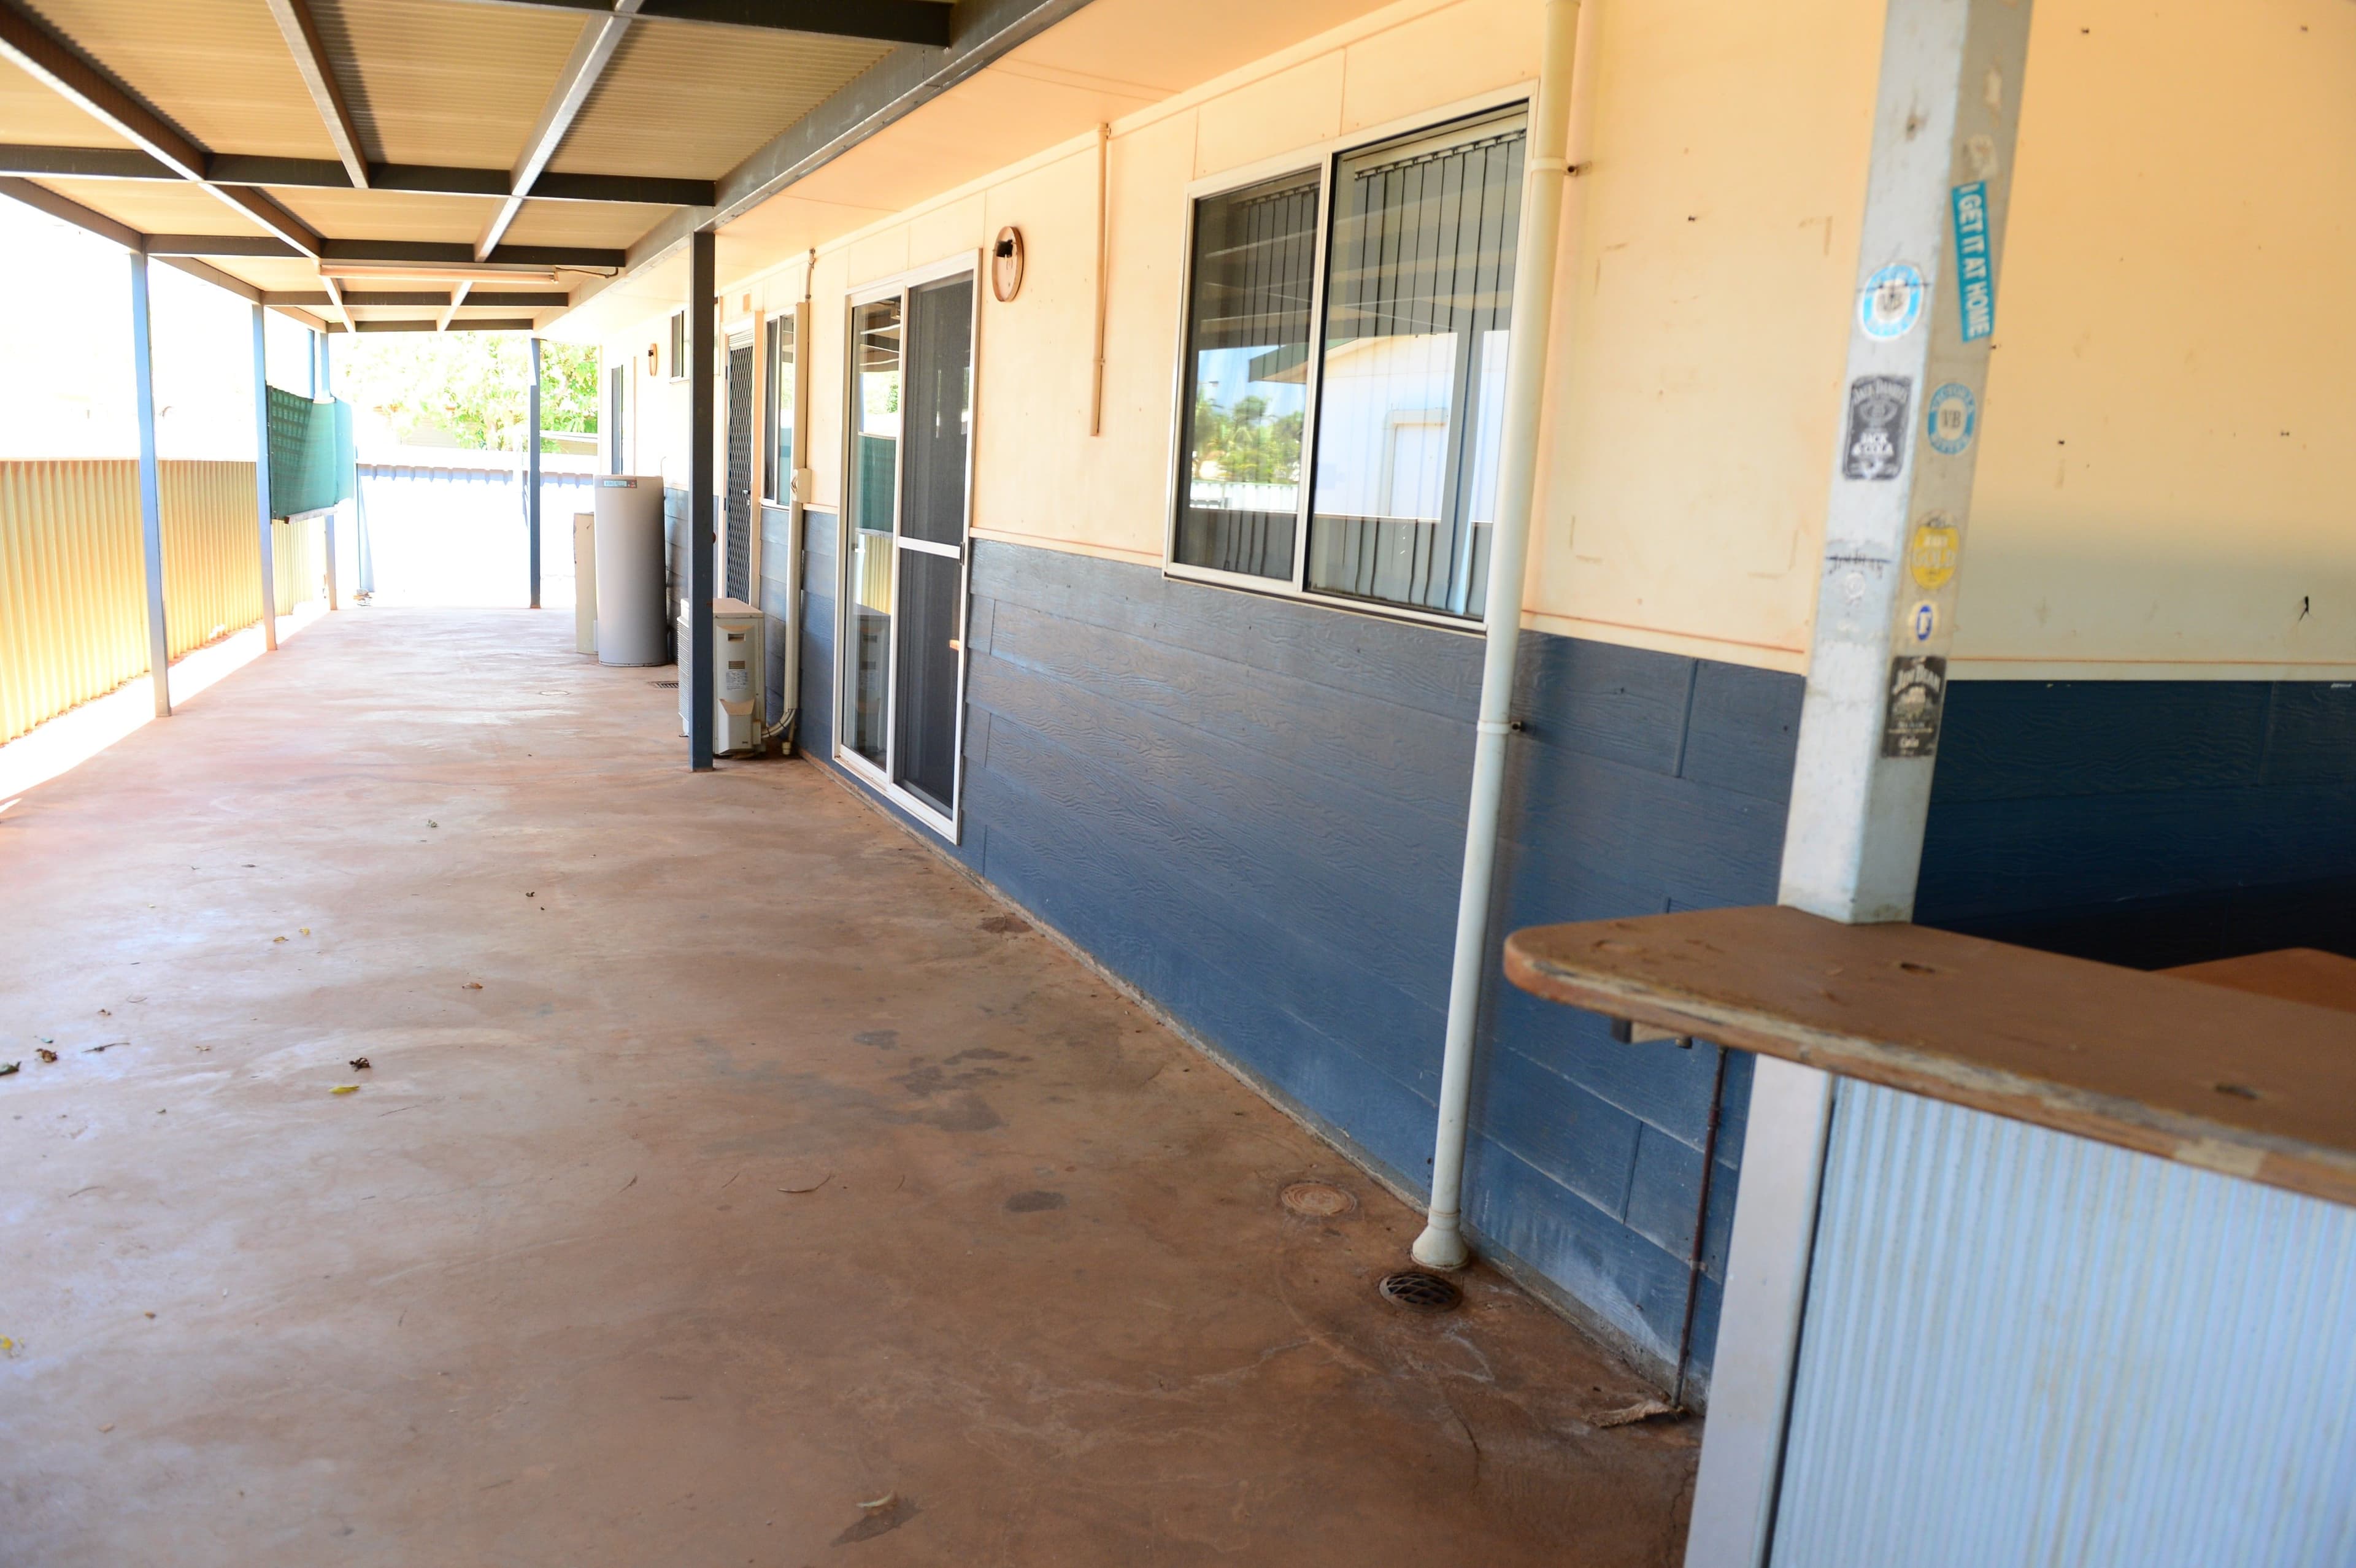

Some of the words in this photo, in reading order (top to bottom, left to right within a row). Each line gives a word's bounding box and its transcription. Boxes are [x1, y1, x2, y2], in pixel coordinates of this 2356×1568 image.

[1958, 194, 1983, 233] GET
[1961, 234, 1985, 254] IT
[1965, 258, 1987, 279] AT
[1966, 280, 1991, 338] HOME
[1942, 409, 1961, 428] VB
